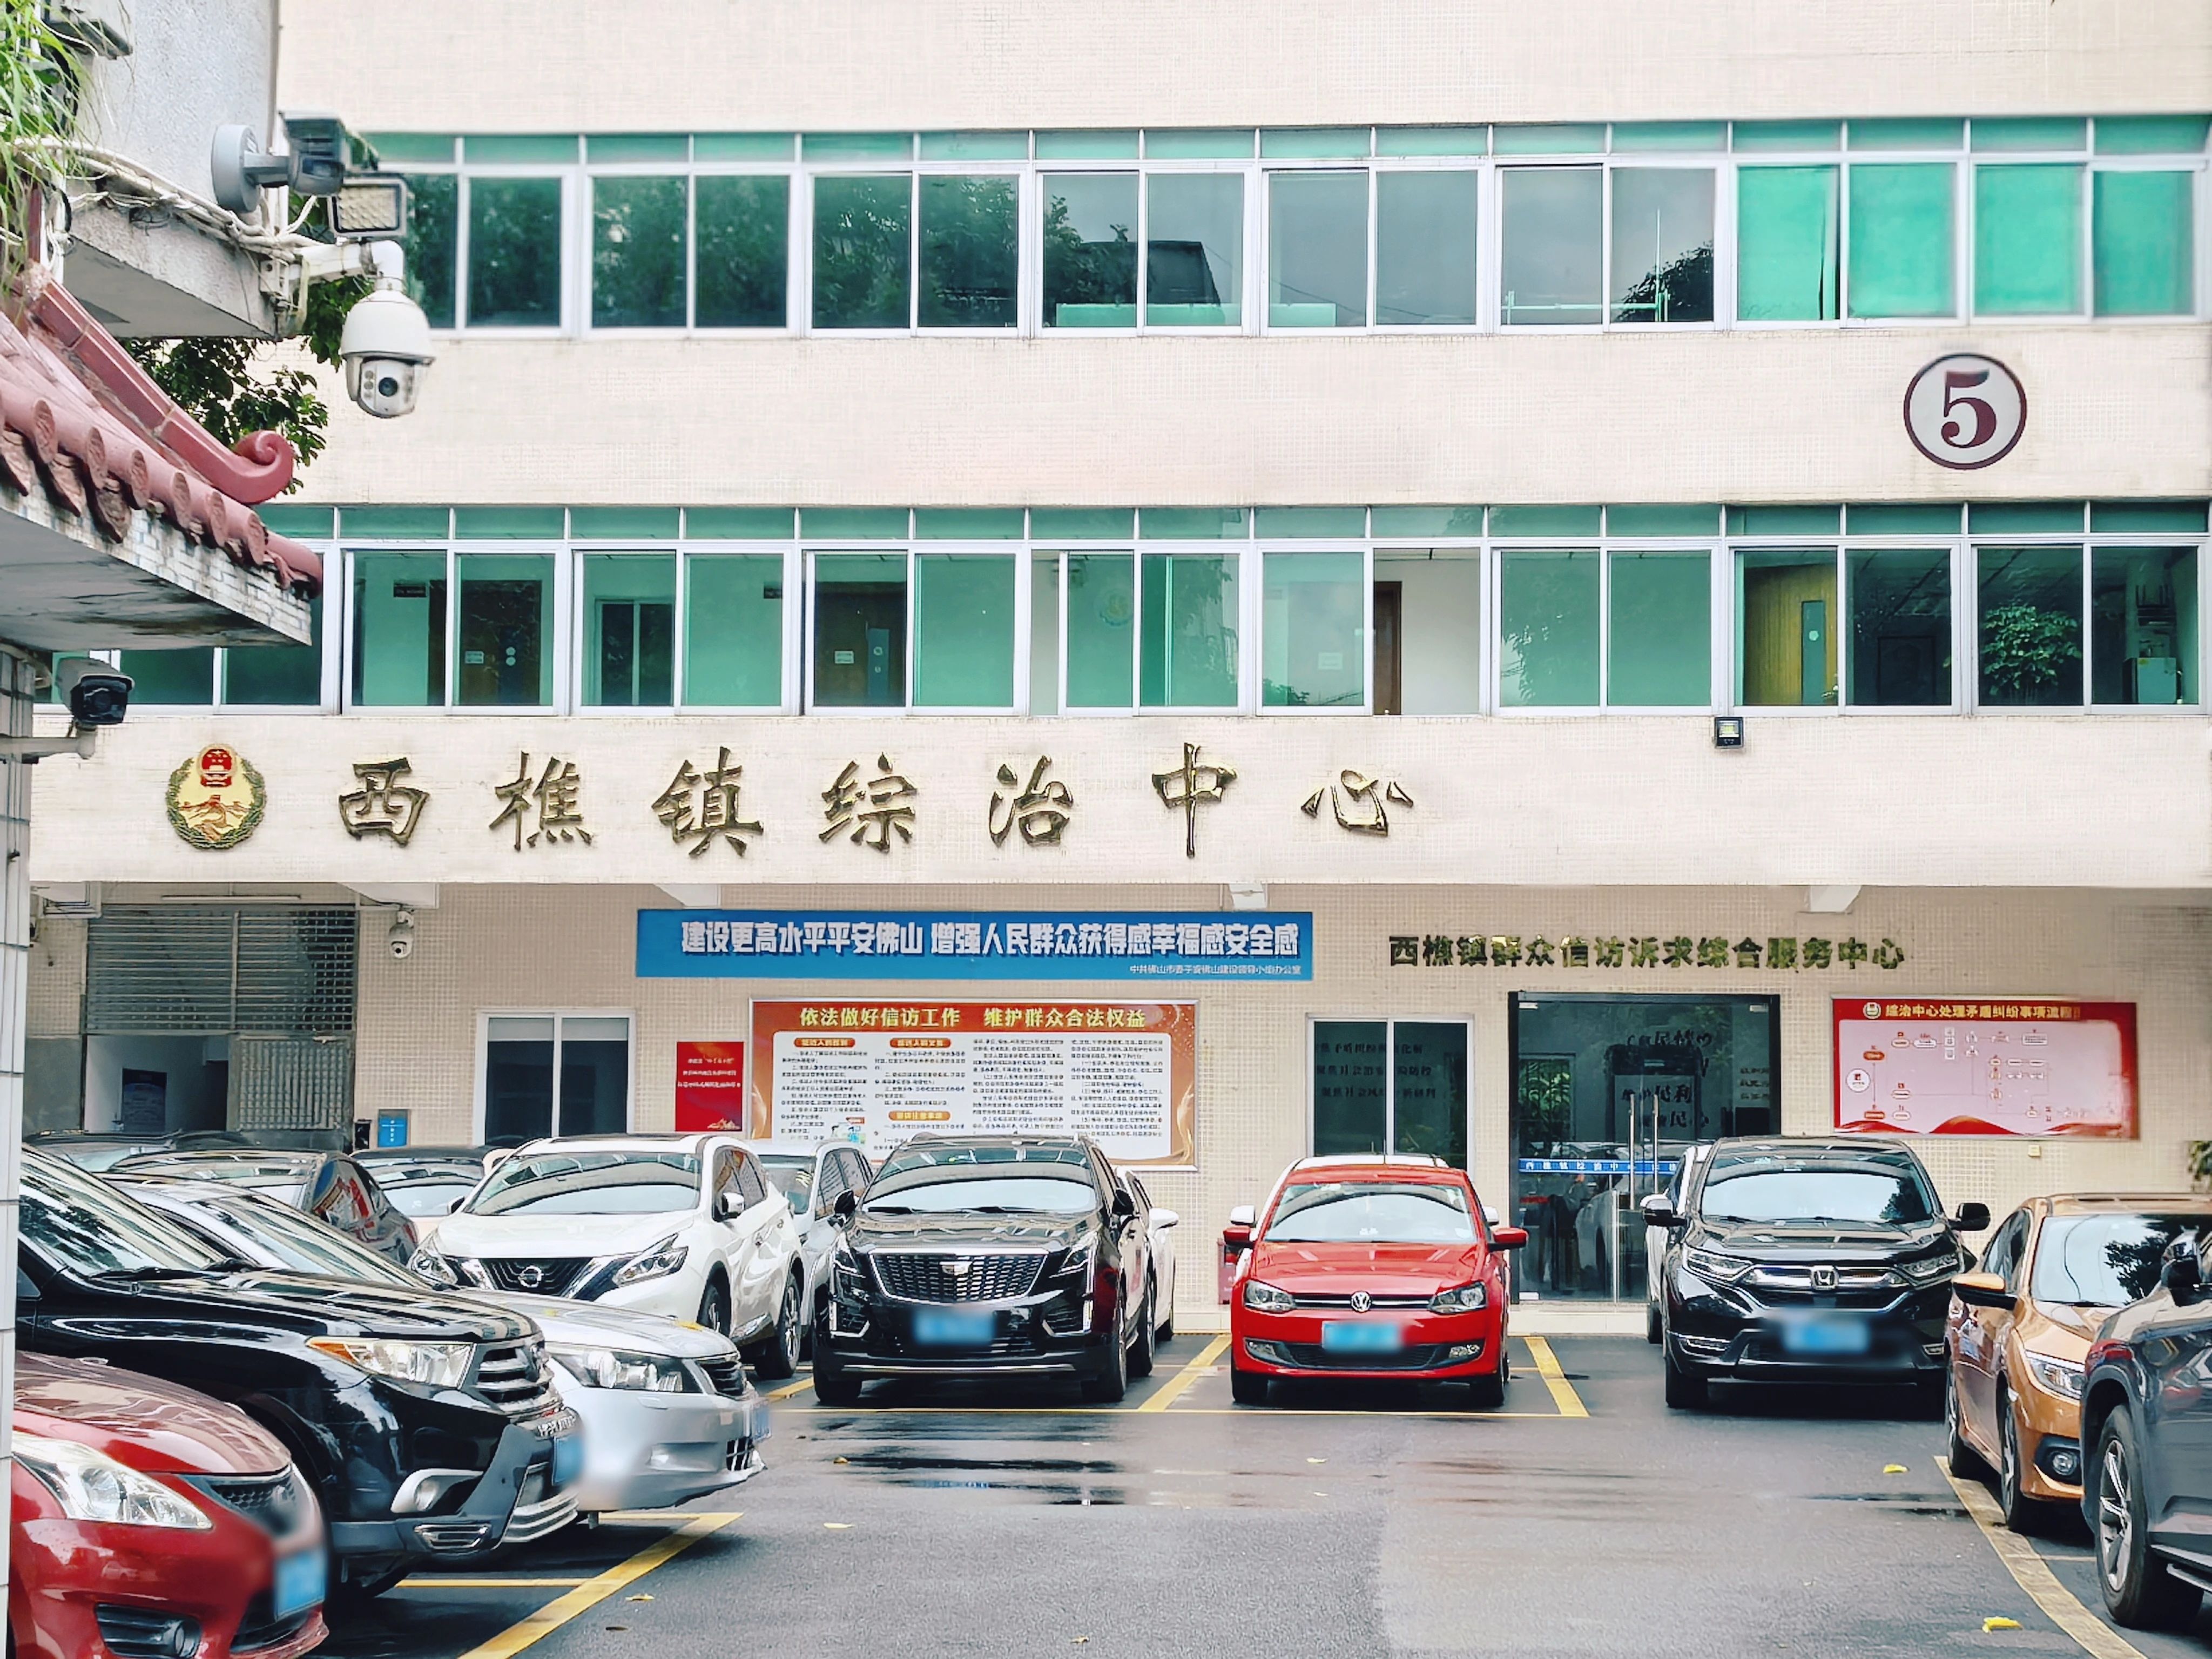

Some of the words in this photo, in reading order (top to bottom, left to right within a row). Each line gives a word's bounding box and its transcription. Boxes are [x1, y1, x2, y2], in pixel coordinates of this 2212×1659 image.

[1941, 369, 1998, 448] 5
[338, 742, 1414, 858] 西樵镇综治中心
[680, 921, 923, 955] 建设更高水平平安佛山
[930, 921, 1299, 956] 增强人民群众获得感幸福感安全感
[1388, 934, 1905, 970] 西樵镇群众信访诉求综合服务中心
[800, 1007, 960, 1027] 依法做好信访工作
[984, 1007, 1147, 1028] 维护群众合法权益
